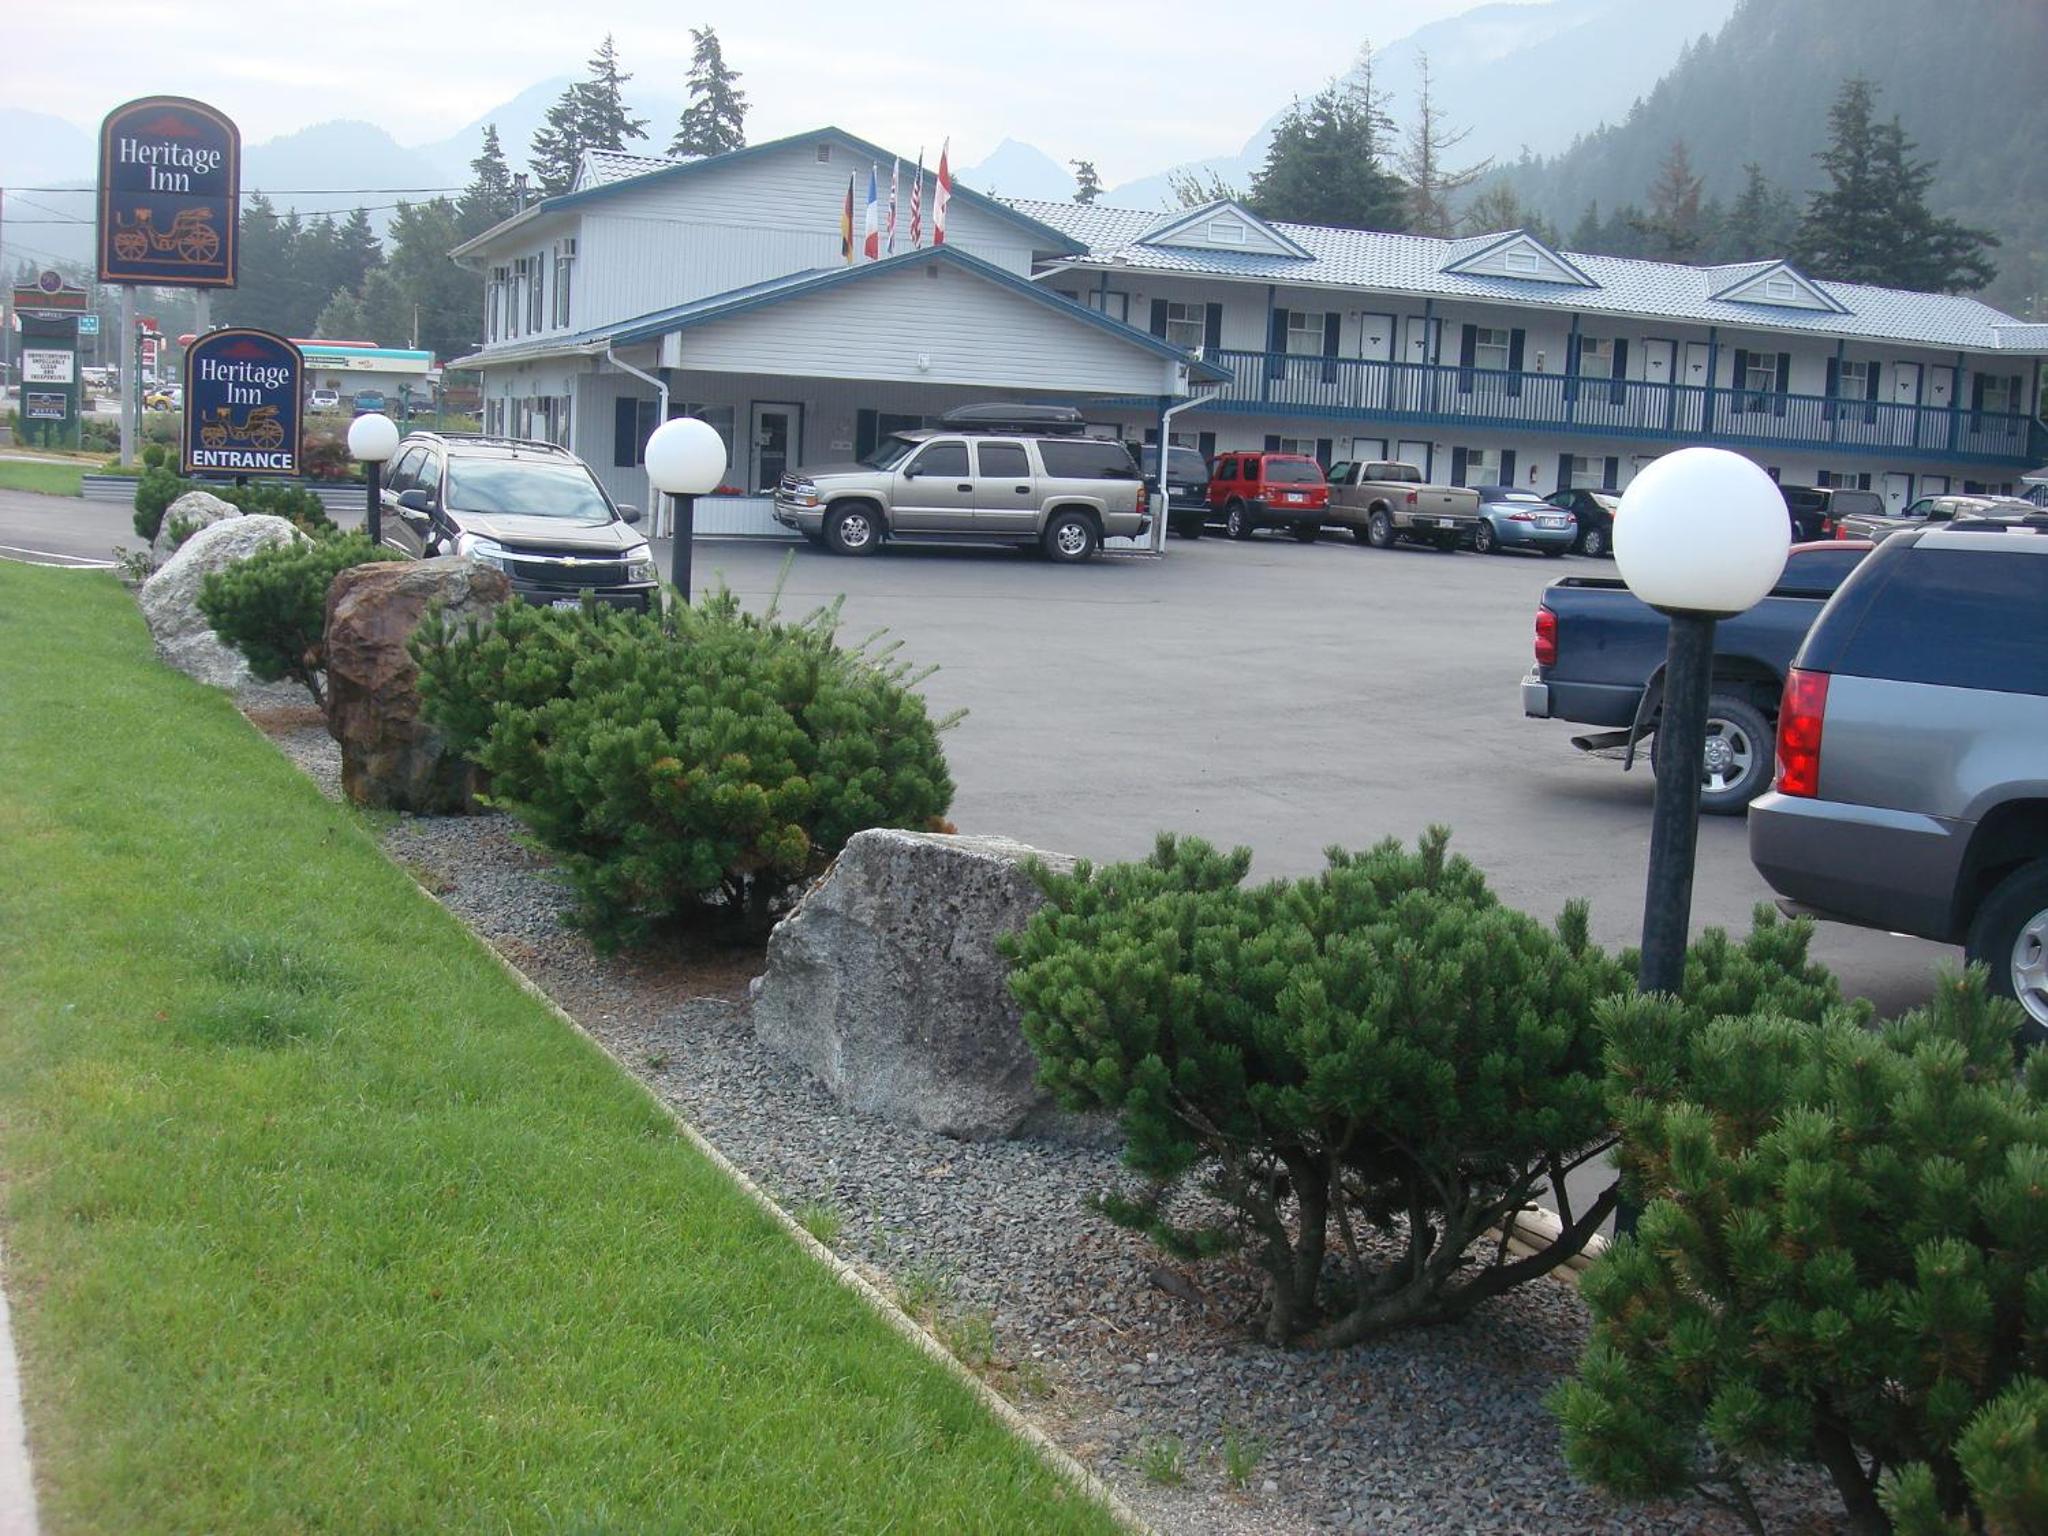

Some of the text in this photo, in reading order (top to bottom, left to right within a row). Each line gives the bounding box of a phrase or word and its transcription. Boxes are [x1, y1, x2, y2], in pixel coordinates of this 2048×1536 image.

[120, 138, 221, 174] Heritage
[149, 166, 191, 192] Inn
[201, 359, 289, 390] Heritage
[227, 383, 262, 405] Inn
[193, 450, 293, 469] ENTRANCE
